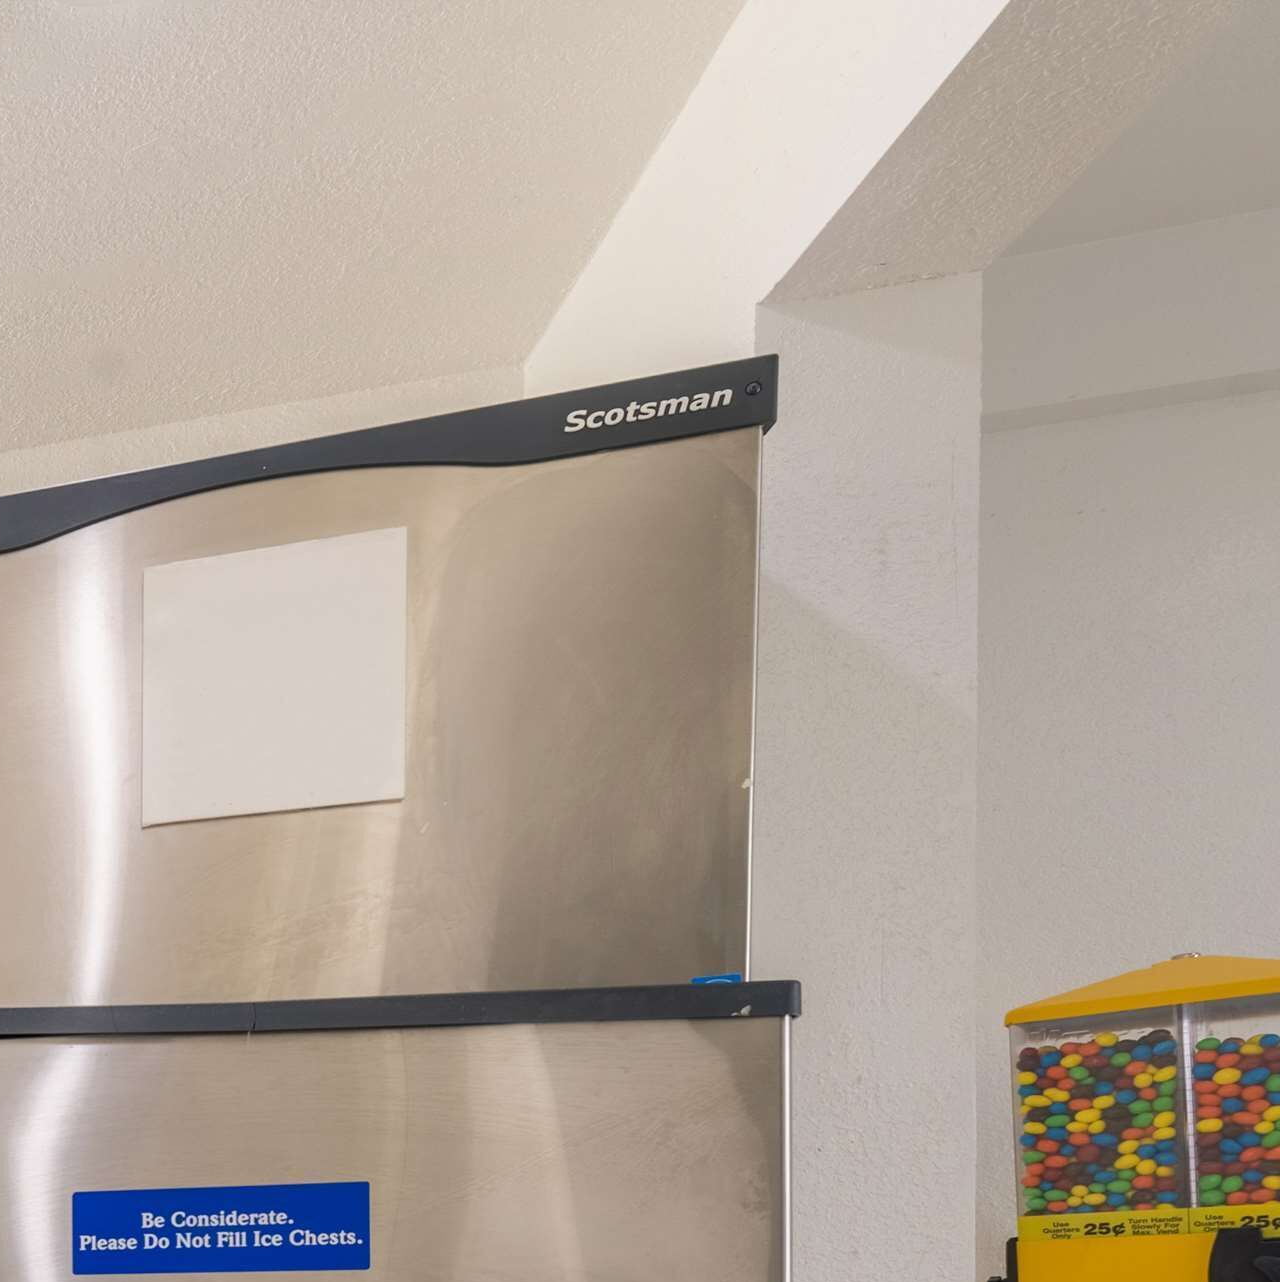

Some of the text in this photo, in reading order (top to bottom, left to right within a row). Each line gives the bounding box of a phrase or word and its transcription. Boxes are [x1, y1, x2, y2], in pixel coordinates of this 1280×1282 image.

[563, 388, 734, 433] Scotsman
[141, 1210, 295, 1229] Be Considerate.
[1193, 1219, 1236, 1227] Quarters
[1042, 1226, 1080, 1234] Quarters
[1083, 1222, 1126, 1237] 25¢
[1131, 1223, 1161, 1231] Slowly
[79, 1229, 364, 1251] Please Do Not Fill Ice Chests.
[1051, 1232, 1072, 1240] Only
